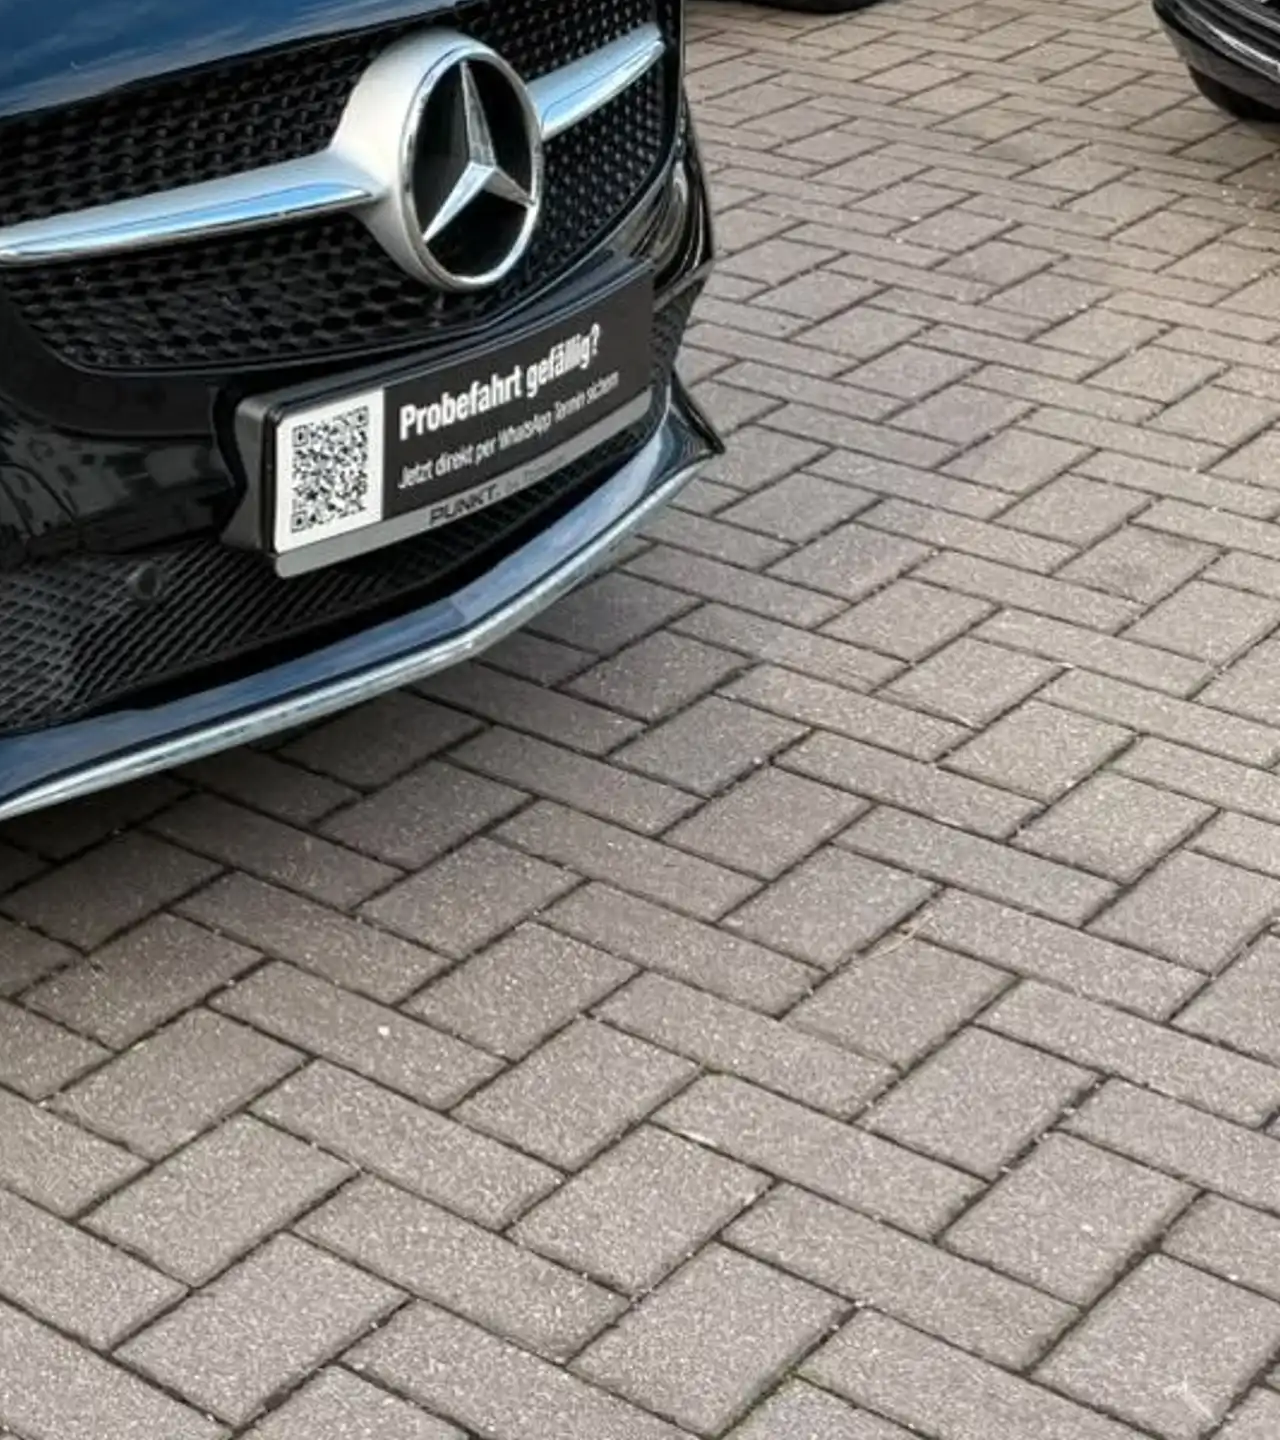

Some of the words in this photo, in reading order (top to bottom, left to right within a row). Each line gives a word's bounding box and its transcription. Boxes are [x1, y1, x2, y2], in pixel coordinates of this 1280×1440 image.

[399, 364, 522, 440] Probefahrt
[526, 323, 601, 398] gefällig?
[397, 460, 434, 489] Jetzt
[435, 444, 474, 477] direkt
[476, 436, 497, 466] per
